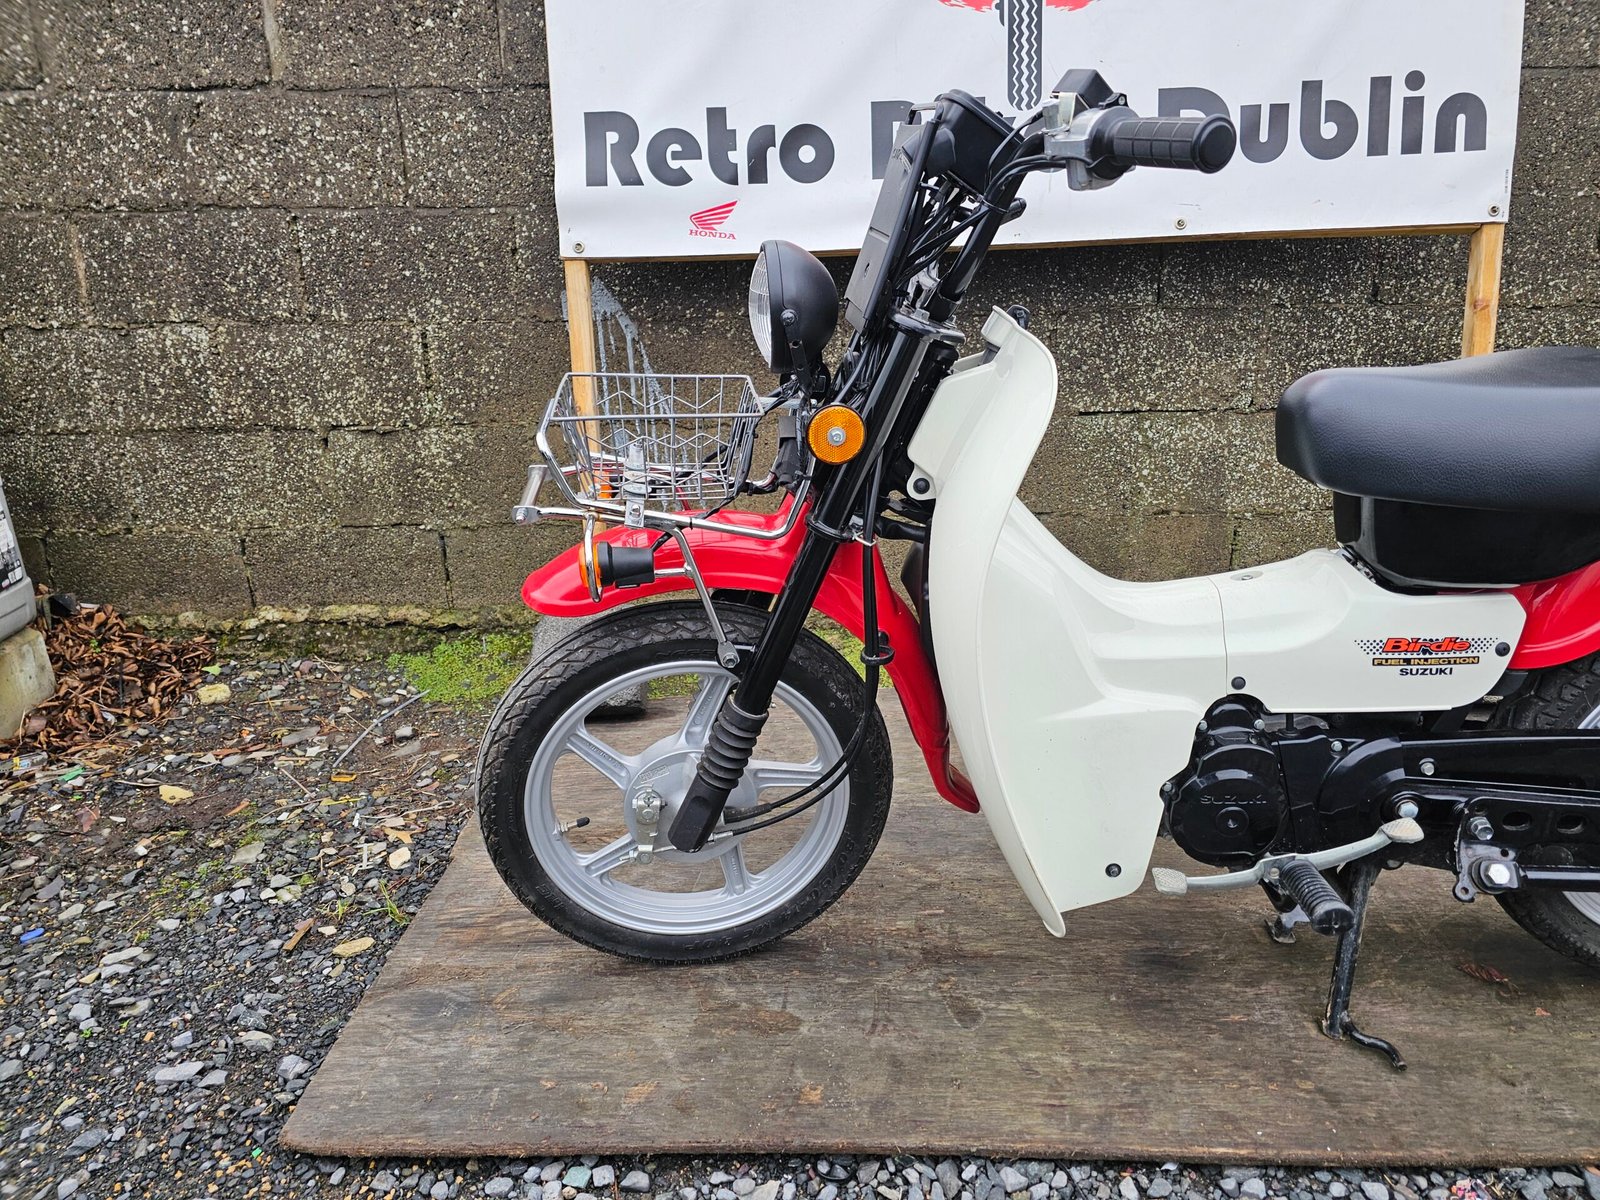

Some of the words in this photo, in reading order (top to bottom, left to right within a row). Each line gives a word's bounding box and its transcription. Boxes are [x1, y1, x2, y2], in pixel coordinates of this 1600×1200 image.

[584, 106, 835, 188] Retro
[688, 228, 737, 240] HONDA
[1381, 637, 1472, 653] Birdie
[1373, 658, 1407, 666] FUEL
[1410, 657, 1479, 665] INJECTION
[1399, 667, 1453, 676] SUZUKI
[1200, 794, 1267, 805] SUZUKI
